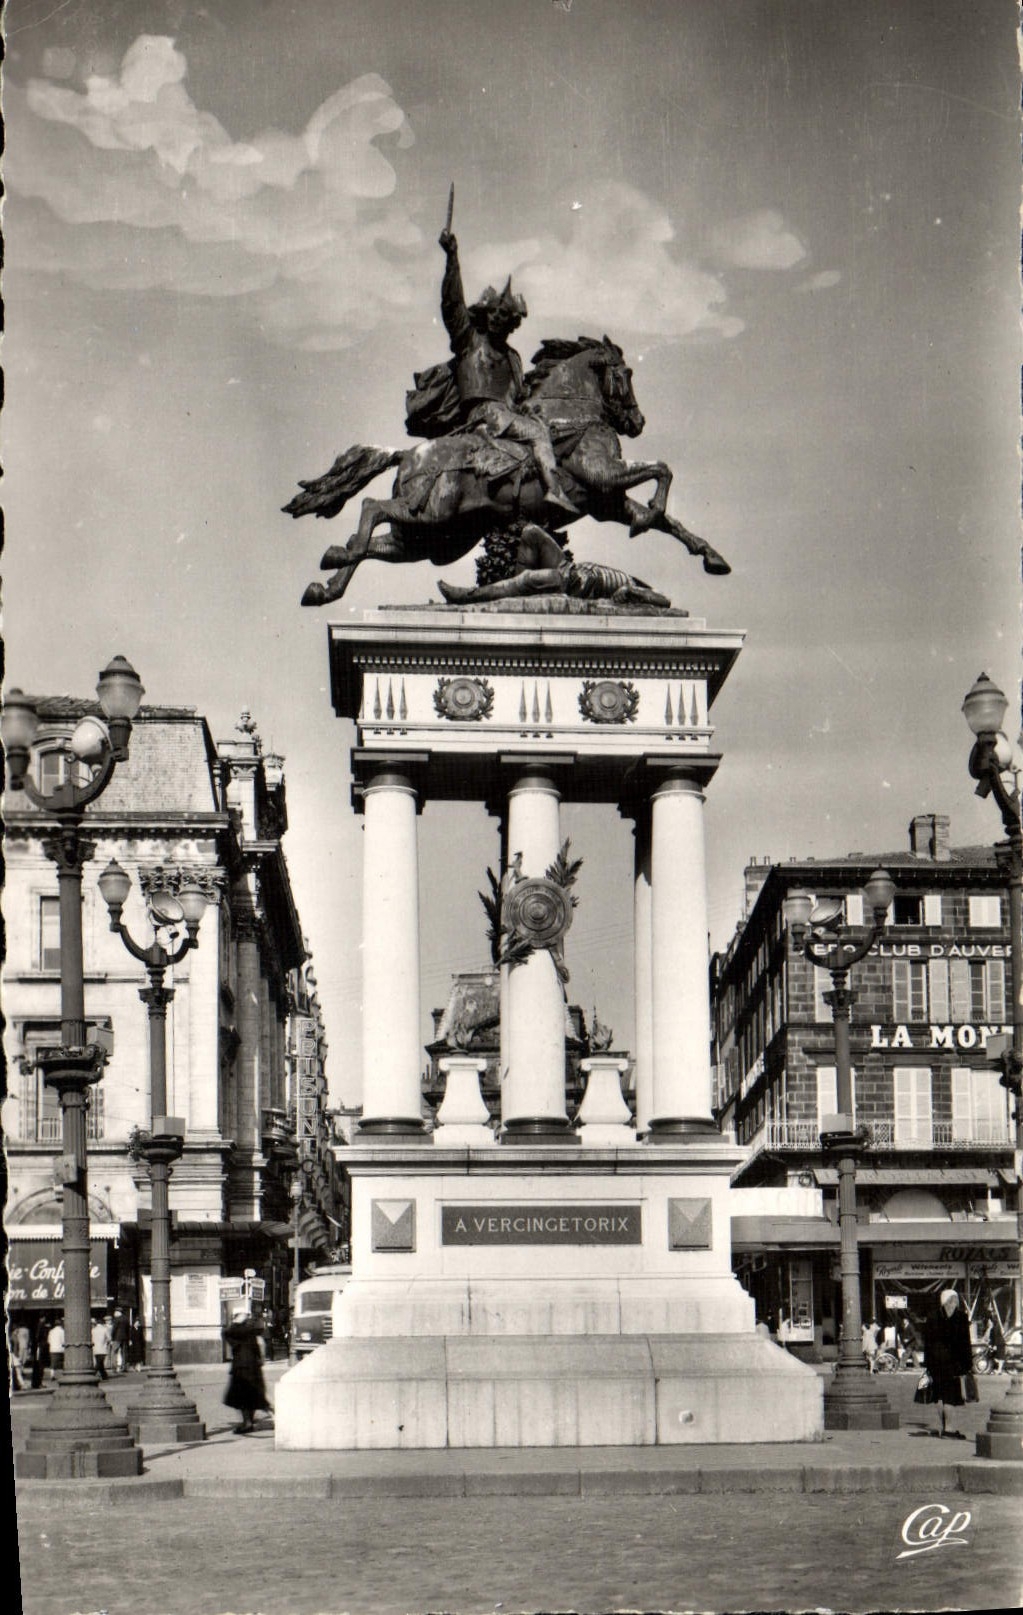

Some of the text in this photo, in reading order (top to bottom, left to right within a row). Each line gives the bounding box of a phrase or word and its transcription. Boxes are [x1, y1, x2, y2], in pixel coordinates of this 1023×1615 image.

[867, 944, 922, 957] CLUB
[870, 1024, 914, 1049] LA
[455, 1216, 629, 1233] A VERCINGETORIX
[31, 1283, 48, 1299] de
